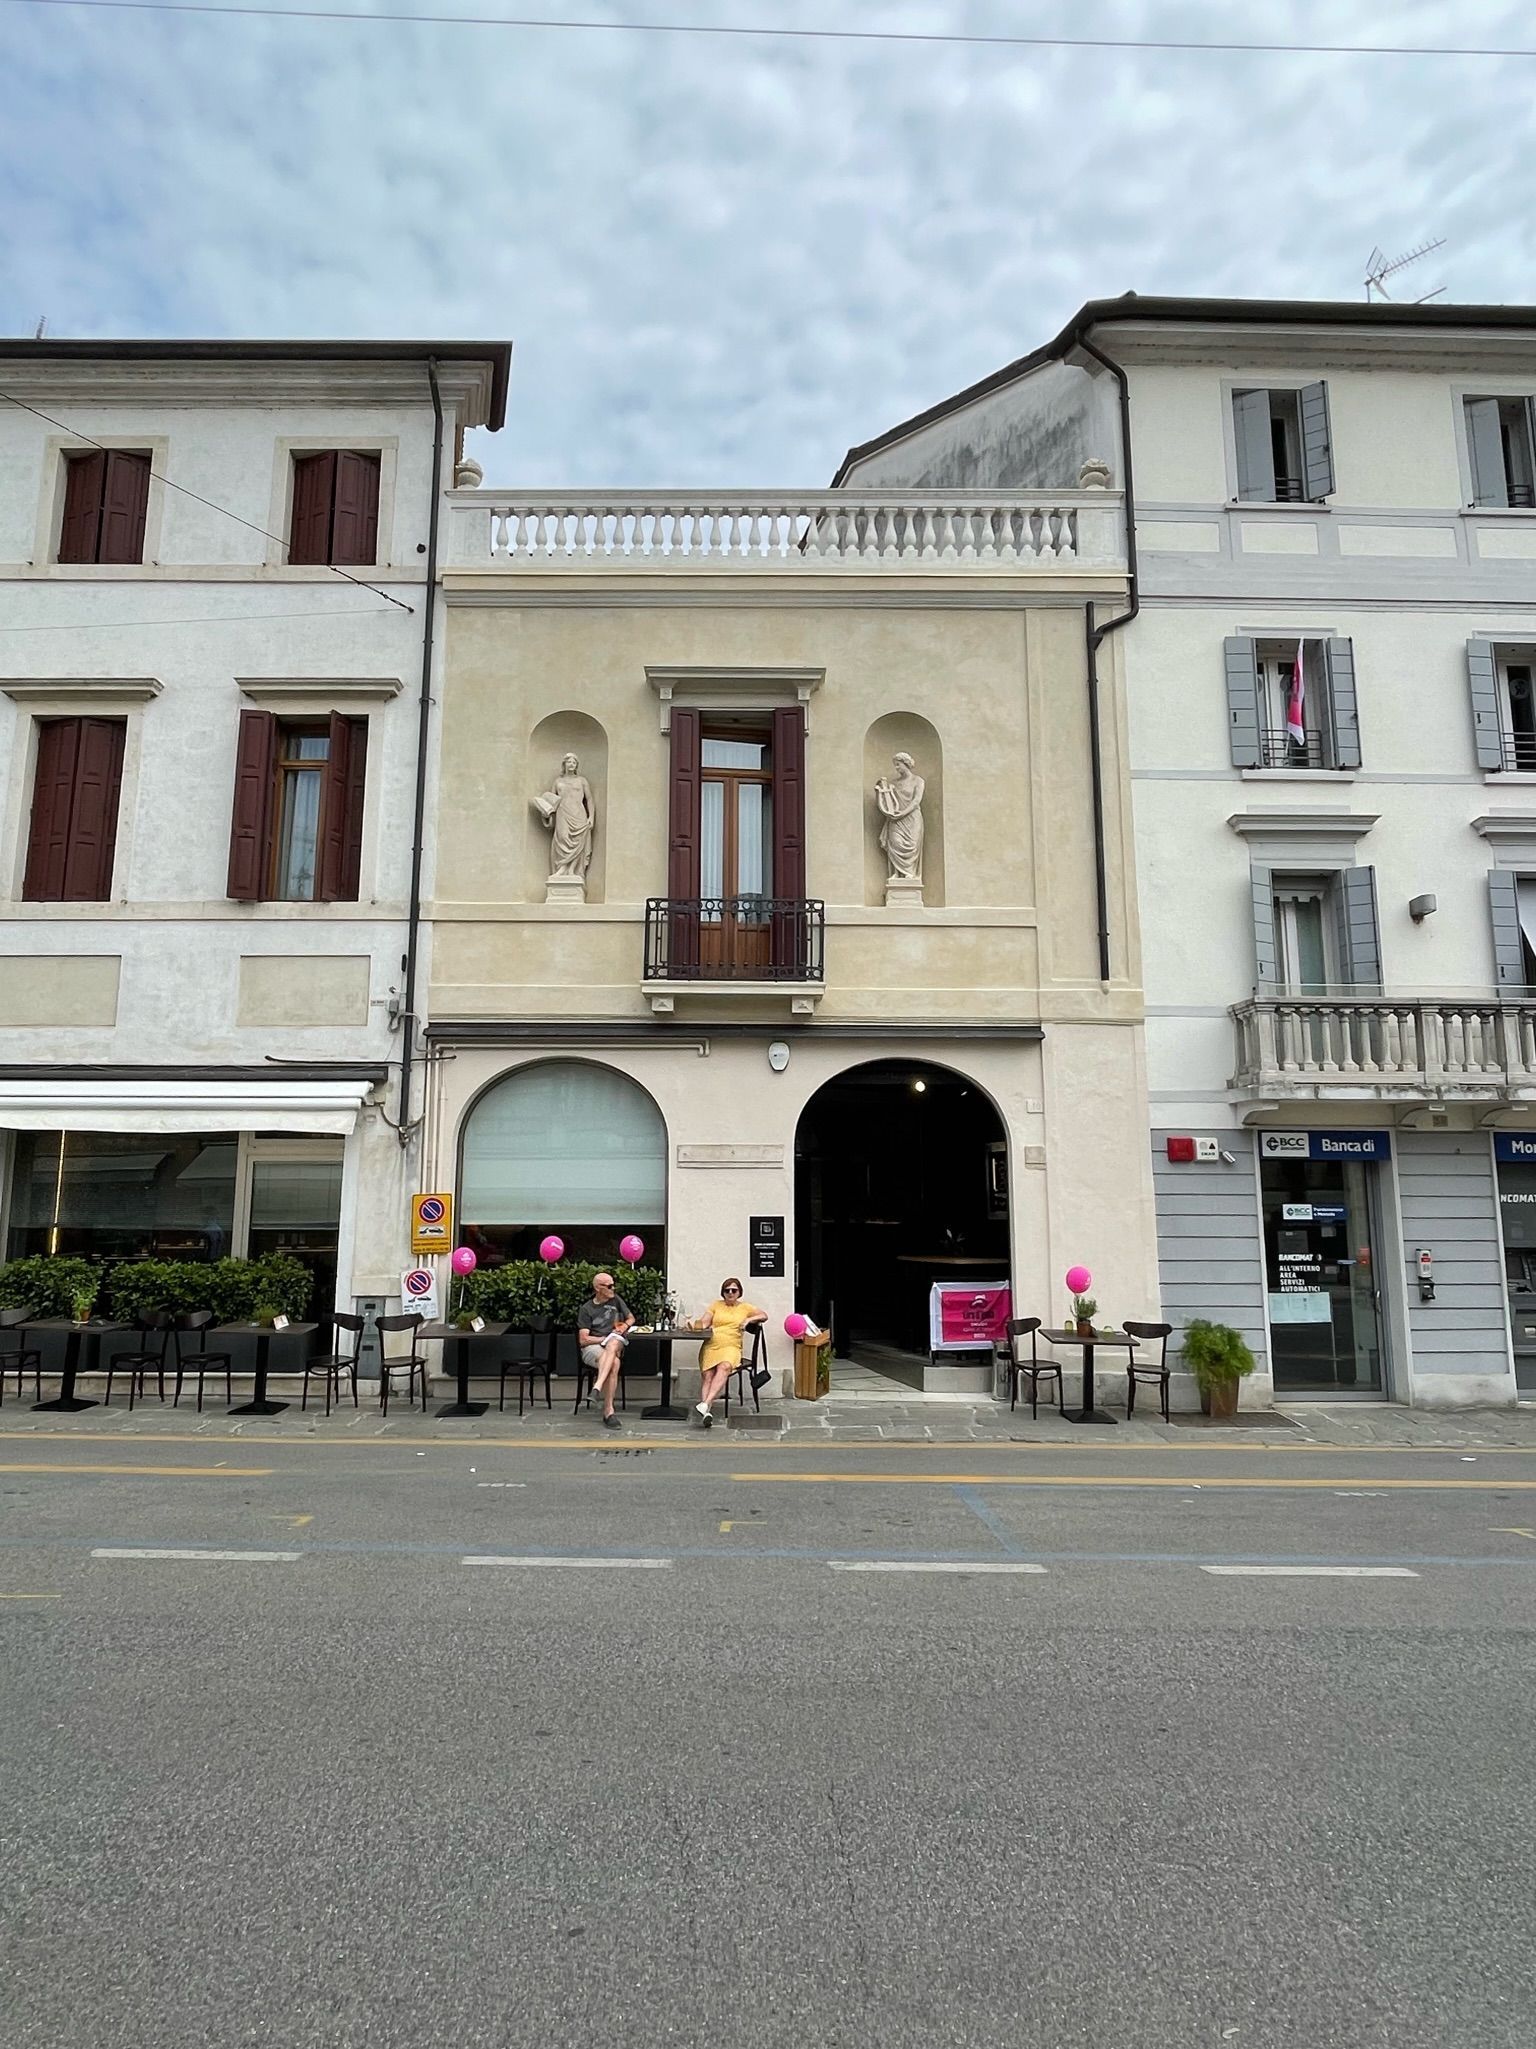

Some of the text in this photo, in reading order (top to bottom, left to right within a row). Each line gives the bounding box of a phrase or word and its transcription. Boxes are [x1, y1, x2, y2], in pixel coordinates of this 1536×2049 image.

[1280, 1137, 1305, 1147] BCC
[1321, 1138, 1375, 1152] Banca di
[1278, 1253, 1313, 1261] BANCOMAT
[1280, 1278, 1305, 1286] SERVIZI
